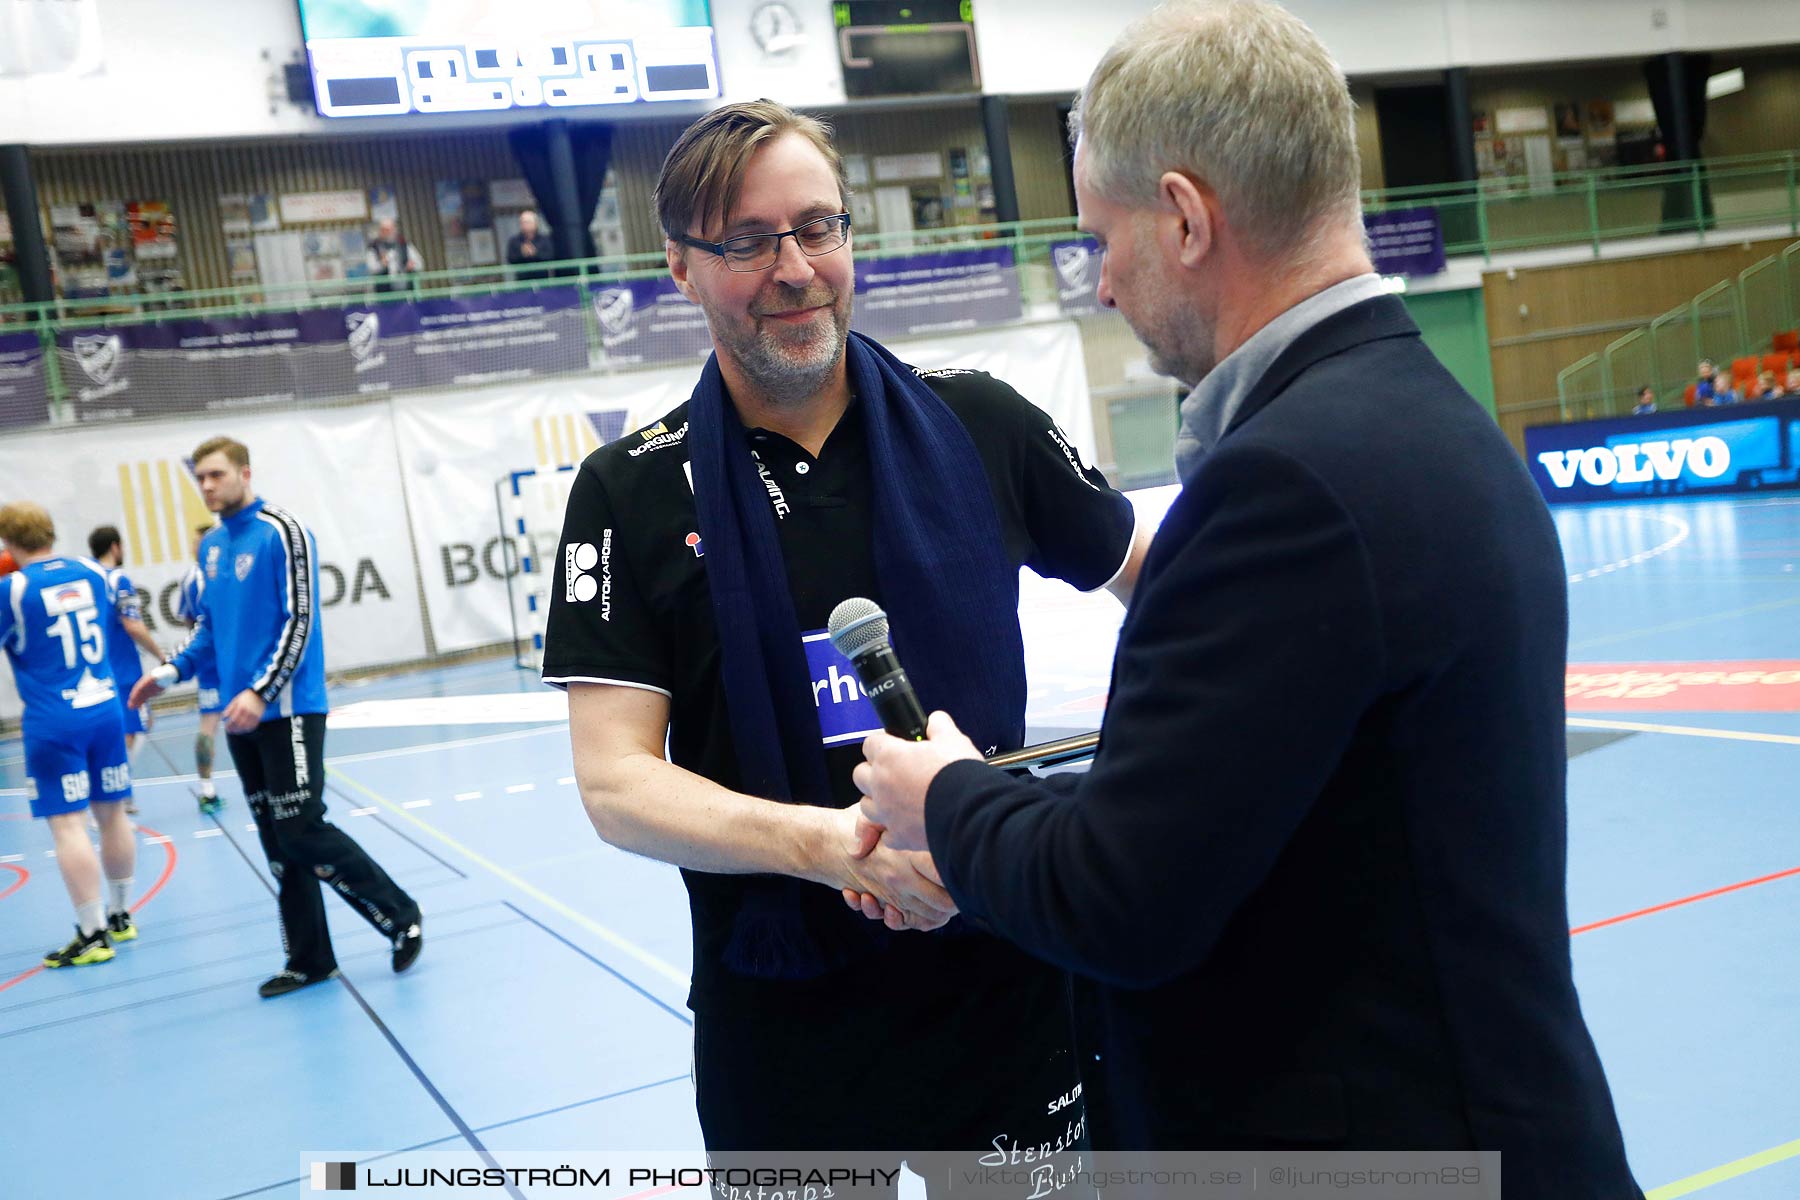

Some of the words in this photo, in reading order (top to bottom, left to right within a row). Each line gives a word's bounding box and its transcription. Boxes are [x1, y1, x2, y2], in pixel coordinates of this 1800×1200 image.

[1537, 436, 1731, 488] VOLVO
[601, 528, 613, 622] AUTOKAROSS
[46, 607, 105, 670] 15
[868, 679, 896, 699] MIC
[898, 674, 906, 683] 1
